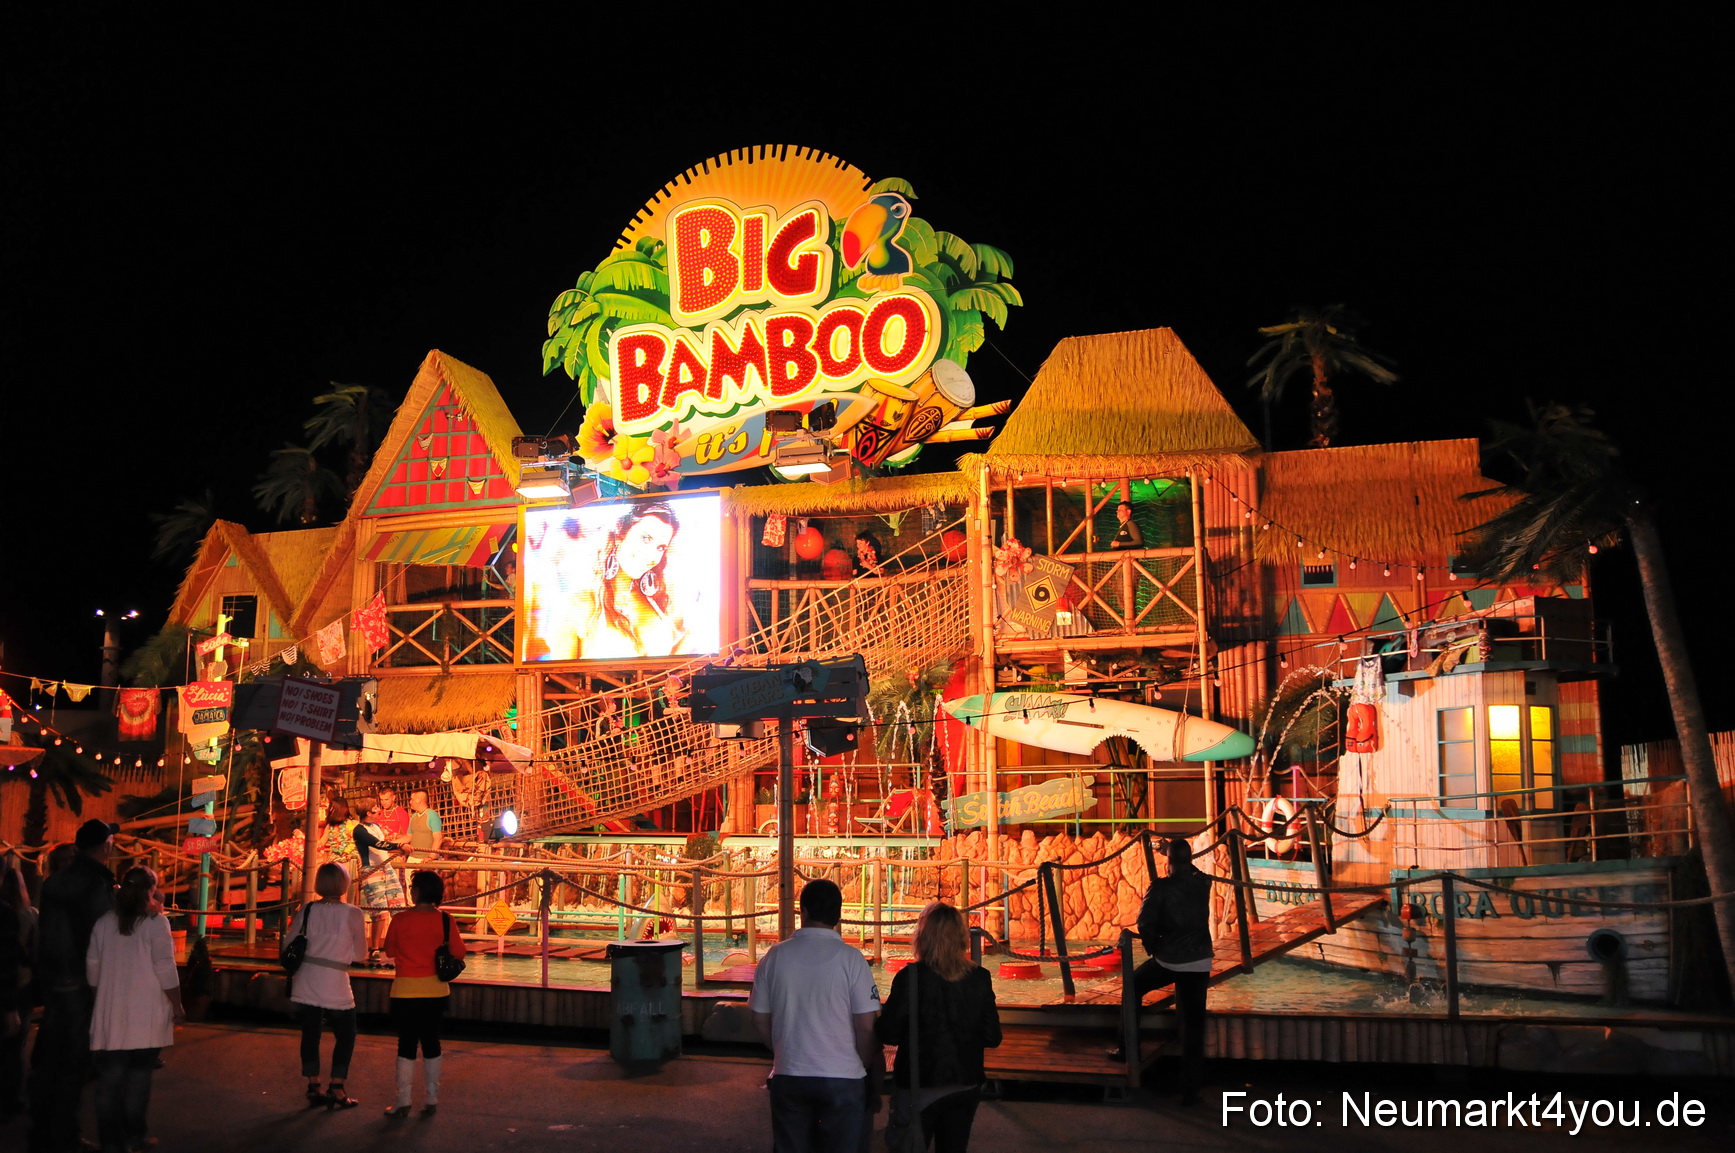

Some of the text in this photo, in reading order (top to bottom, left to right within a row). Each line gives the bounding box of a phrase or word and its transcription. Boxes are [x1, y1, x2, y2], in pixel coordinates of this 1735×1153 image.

[673, 204, 822, 316] BIG
[615, 294, 930, 424] BAMBOO
[694, 425, 749, 465] it's
[1036, 558, 1070, 580] STORM
[1011, 608, 1052, 633] WARNING
[285, 685, 335, 705] NO! SHOES
[730, 672, 783, 699] CUBAN
[281, 698, 299, 711] NO!
[732, 688, 785, 713] CIGARS
[195, 710, 225, 722] JAMAICA
[279, 711, 333, 733] NO! PROBLEM
[1023, 786, 1084, 816] Beach
[616, 1000, 667, 1016] ABFALL
